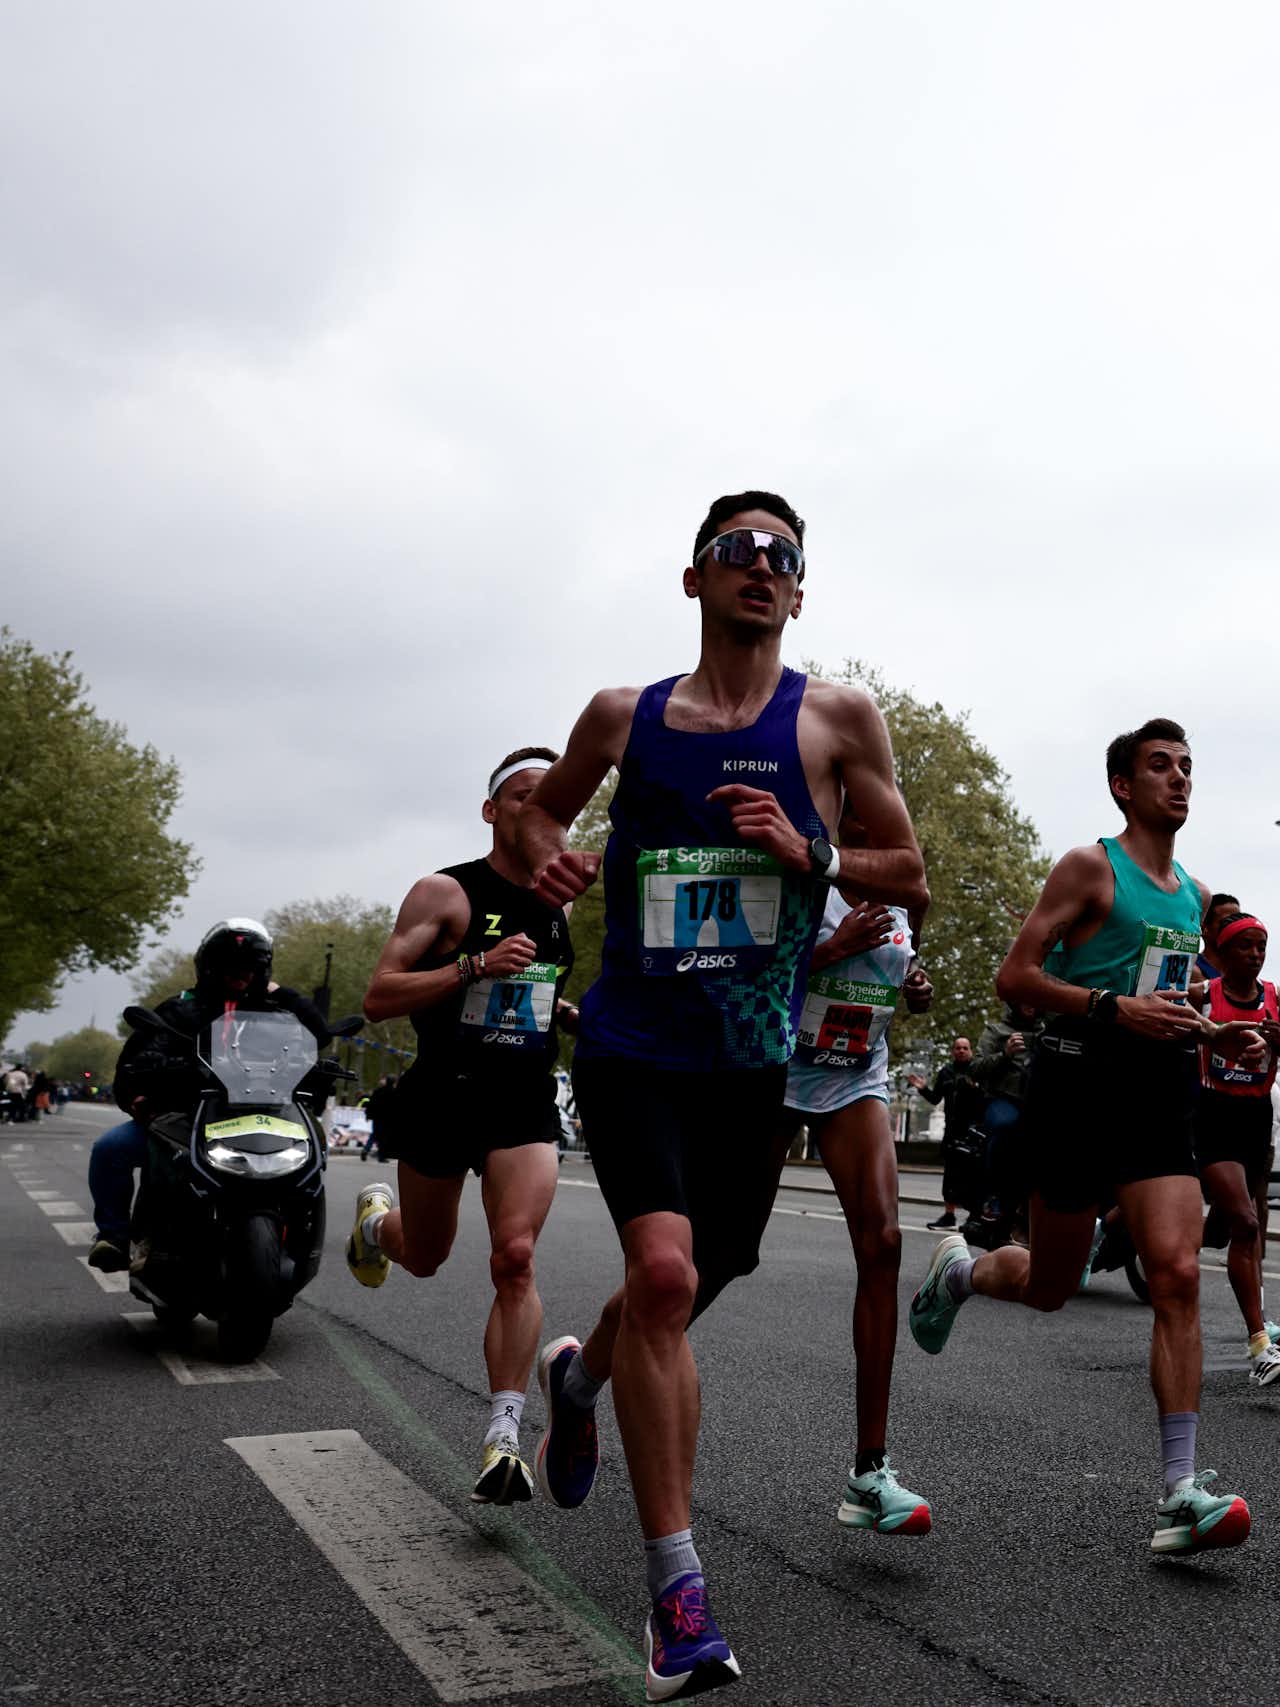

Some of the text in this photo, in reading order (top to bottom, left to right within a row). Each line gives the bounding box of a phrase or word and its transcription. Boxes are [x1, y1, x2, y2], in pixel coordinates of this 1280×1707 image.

[723, 760, 778, 772] KIPRUN
[677, 847, 766, 863] Schneider
[684, 881, 736, 921] 178
[1165, 955, 1190, 985] 182
[835, 980, 889, 997] Schneider
[797, 1029, 815, 1044] 206
